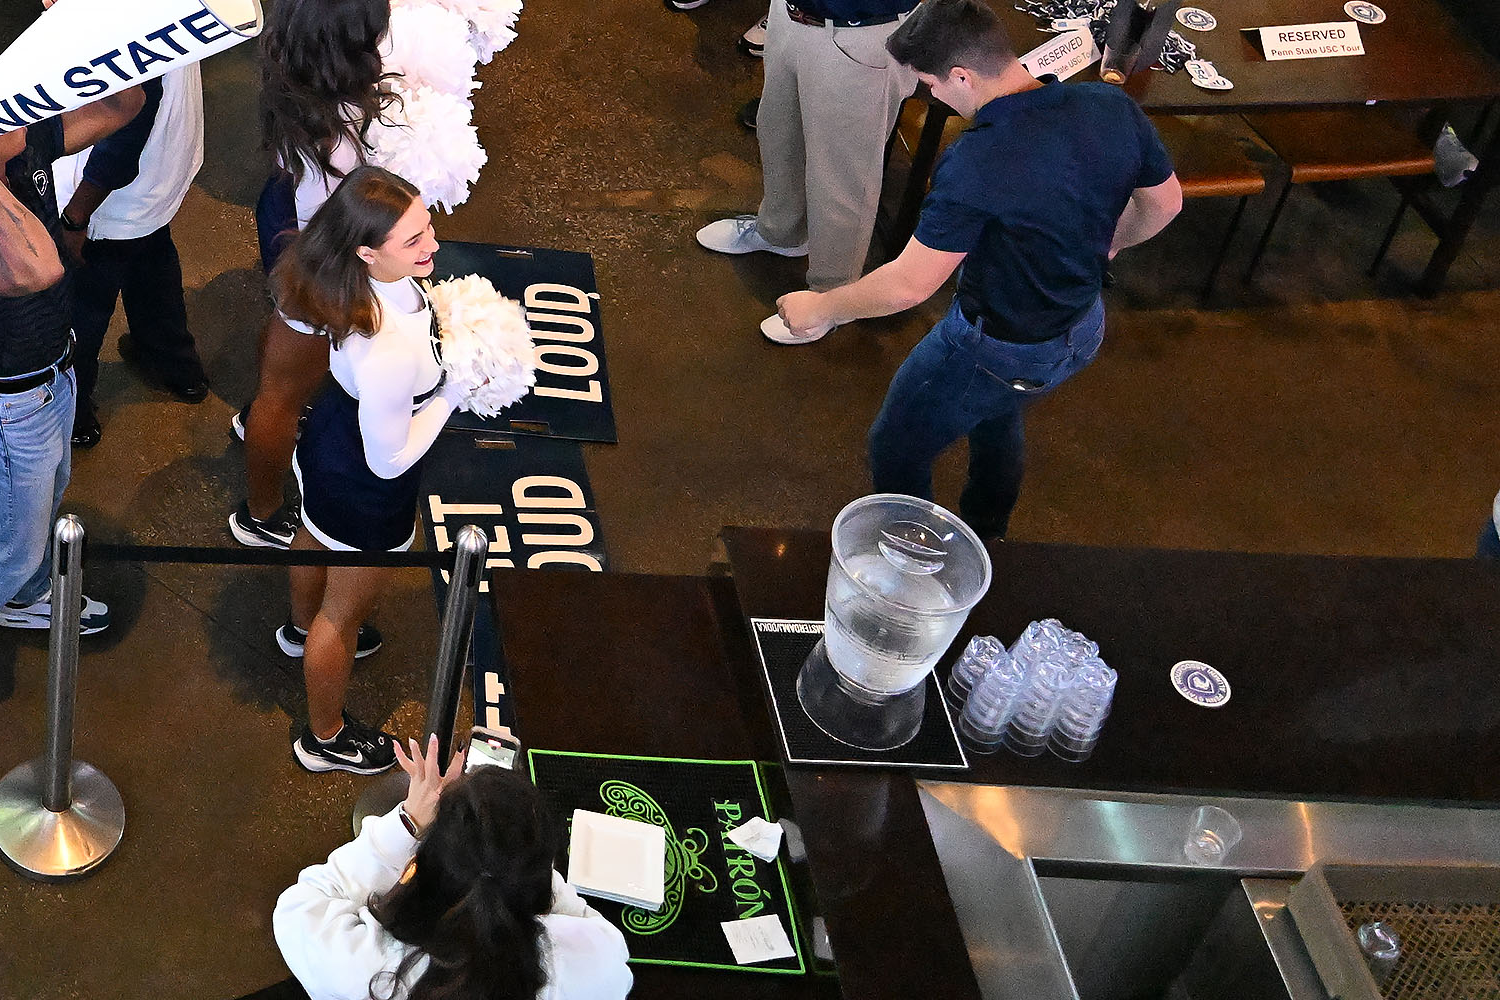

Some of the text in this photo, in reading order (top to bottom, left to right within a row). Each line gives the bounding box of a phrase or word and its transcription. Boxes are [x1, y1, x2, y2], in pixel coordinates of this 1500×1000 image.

[64, 8, 231, 98] STATE
[1038, 35, 1083, 70] RESERVED
[1271, 44, 1361, 57] Penn State USC Tour
[1278, 29, 1346, 42] RESERVED
[524, 282, 603, 403] LOUD
